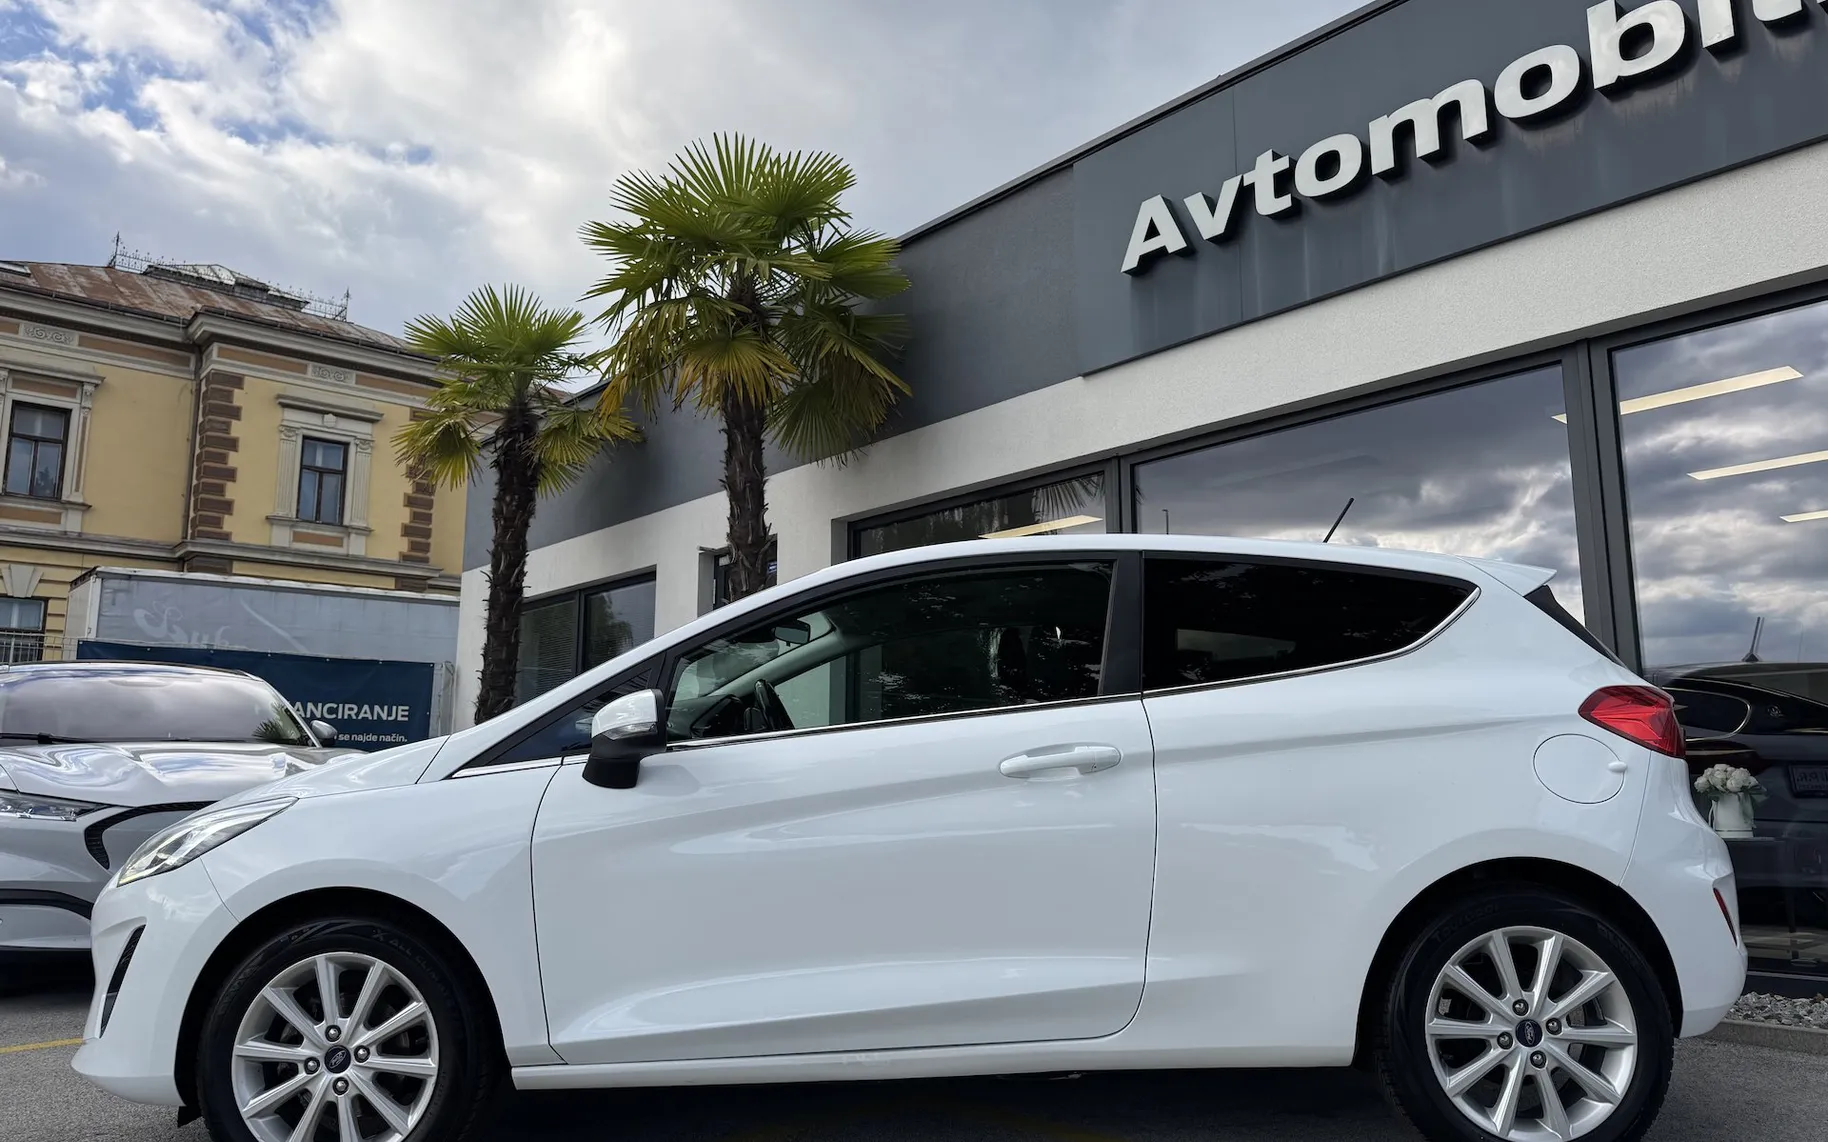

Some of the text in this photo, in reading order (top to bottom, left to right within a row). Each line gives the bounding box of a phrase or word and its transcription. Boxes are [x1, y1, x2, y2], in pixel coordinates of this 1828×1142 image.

[1121, 0, 1828, 273] Avtomob
[291, 701, 410, 722] ANCIRANJE
[351, 733, 378, 742] najde
[379, 733, 408, 743] način.
